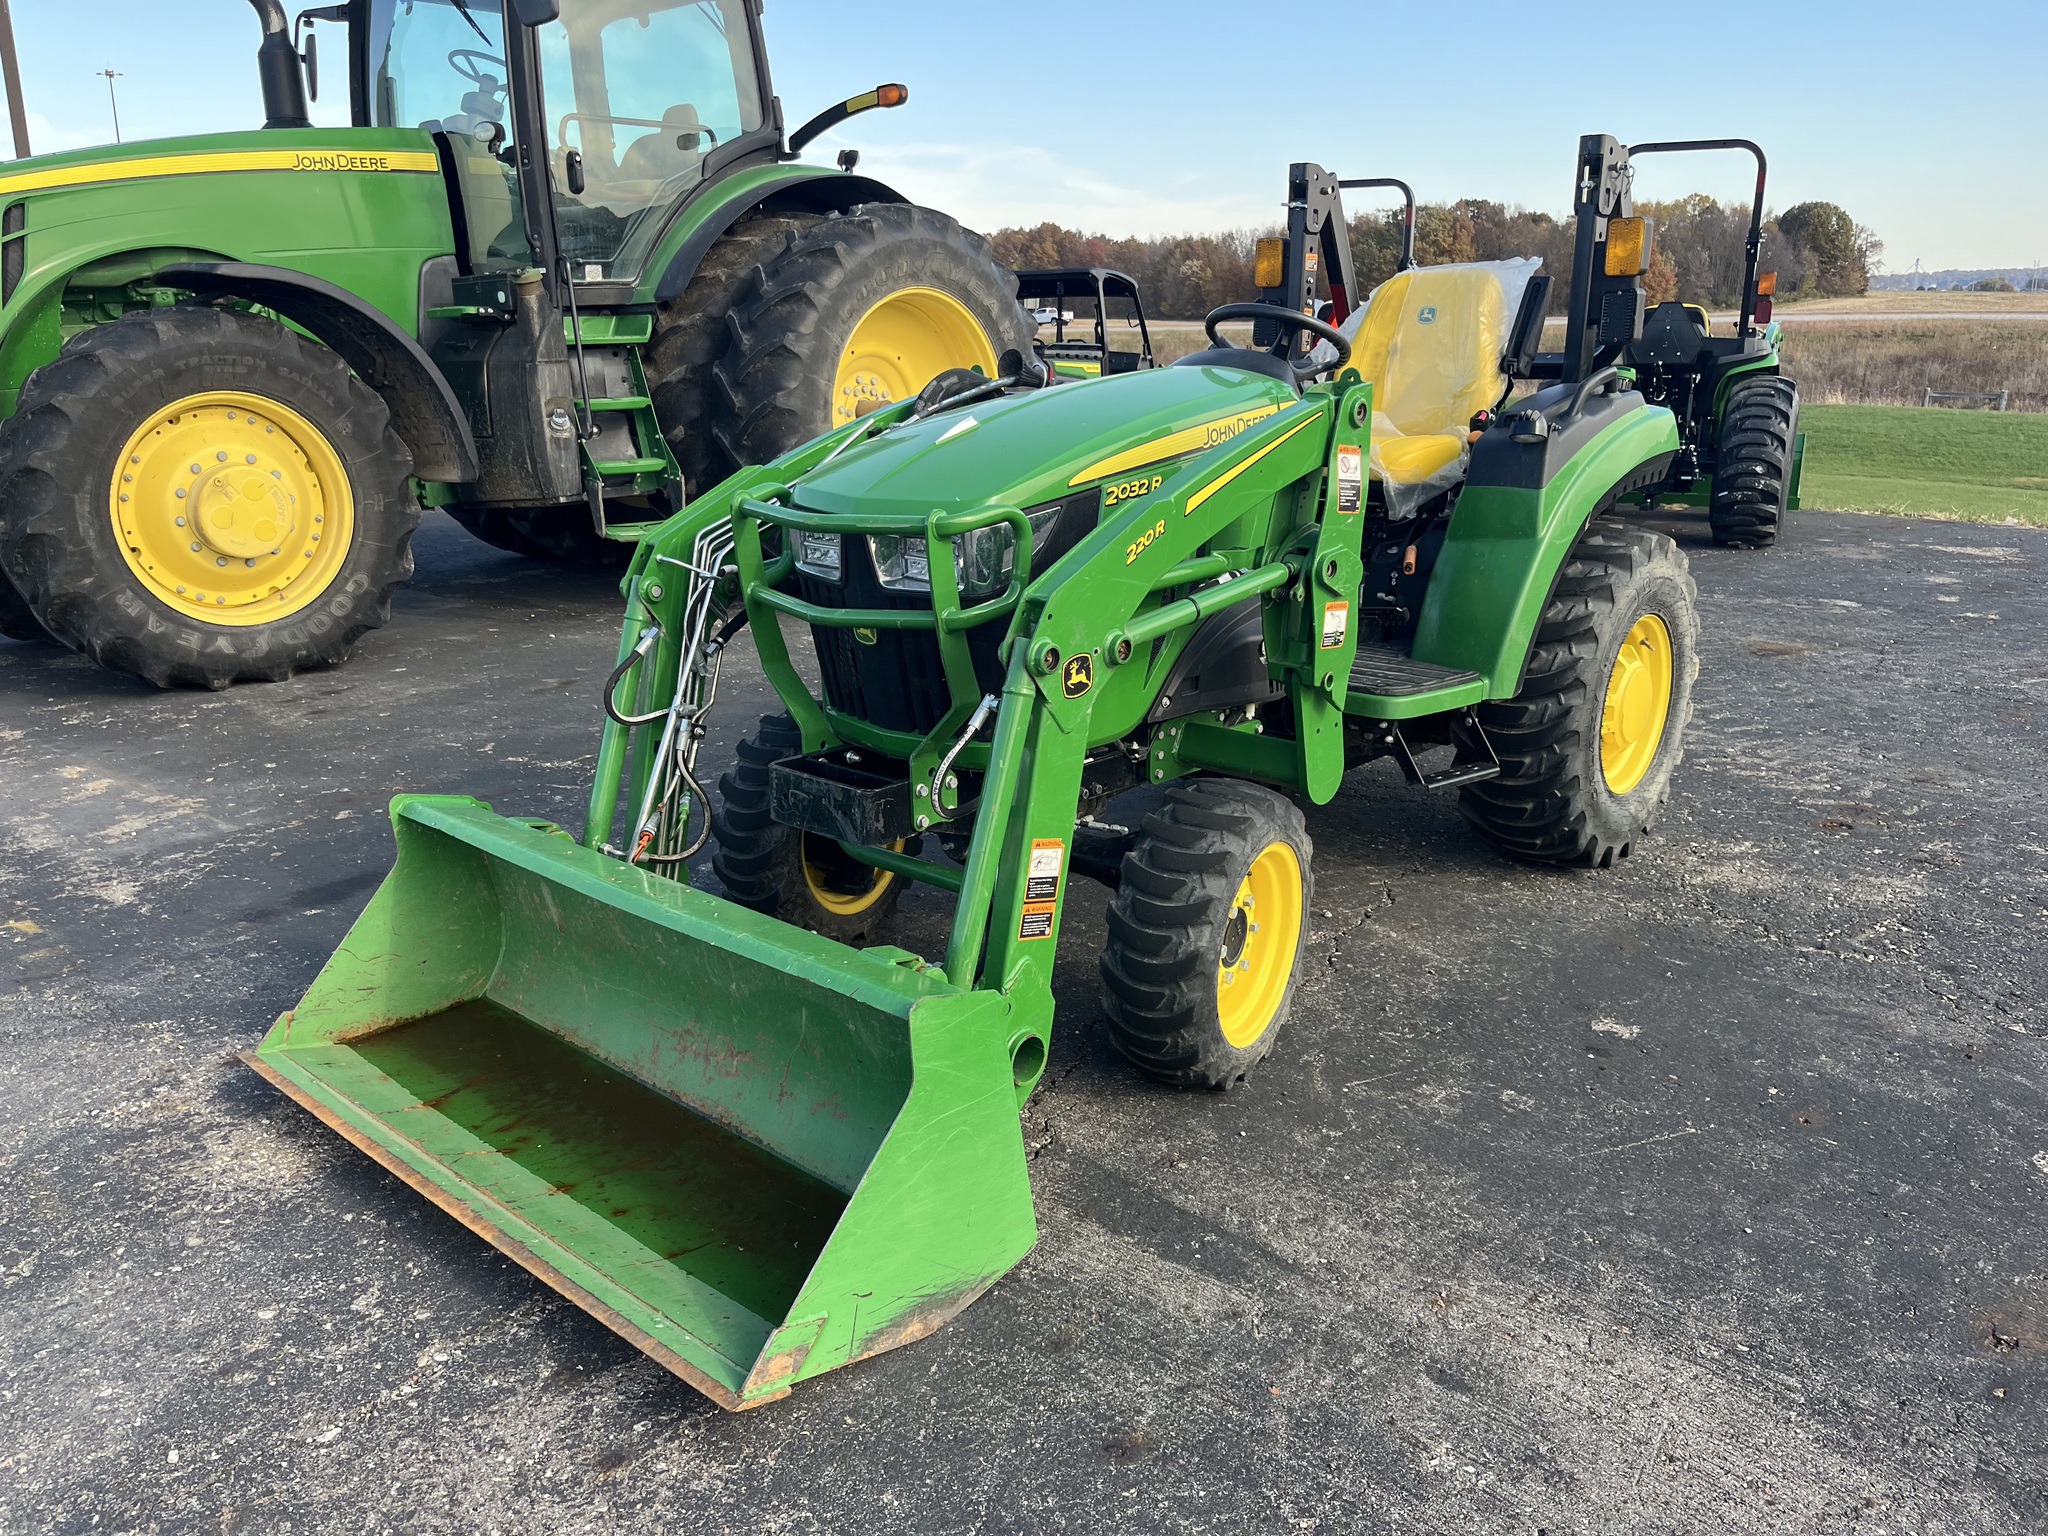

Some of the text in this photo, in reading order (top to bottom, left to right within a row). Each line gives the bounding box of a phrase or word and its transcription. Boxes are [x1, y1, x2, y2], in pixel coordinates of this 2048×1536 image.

[292, 153, 389, 169] JOHN DEERE
[1203, 423, 1236, 446] JOHN
